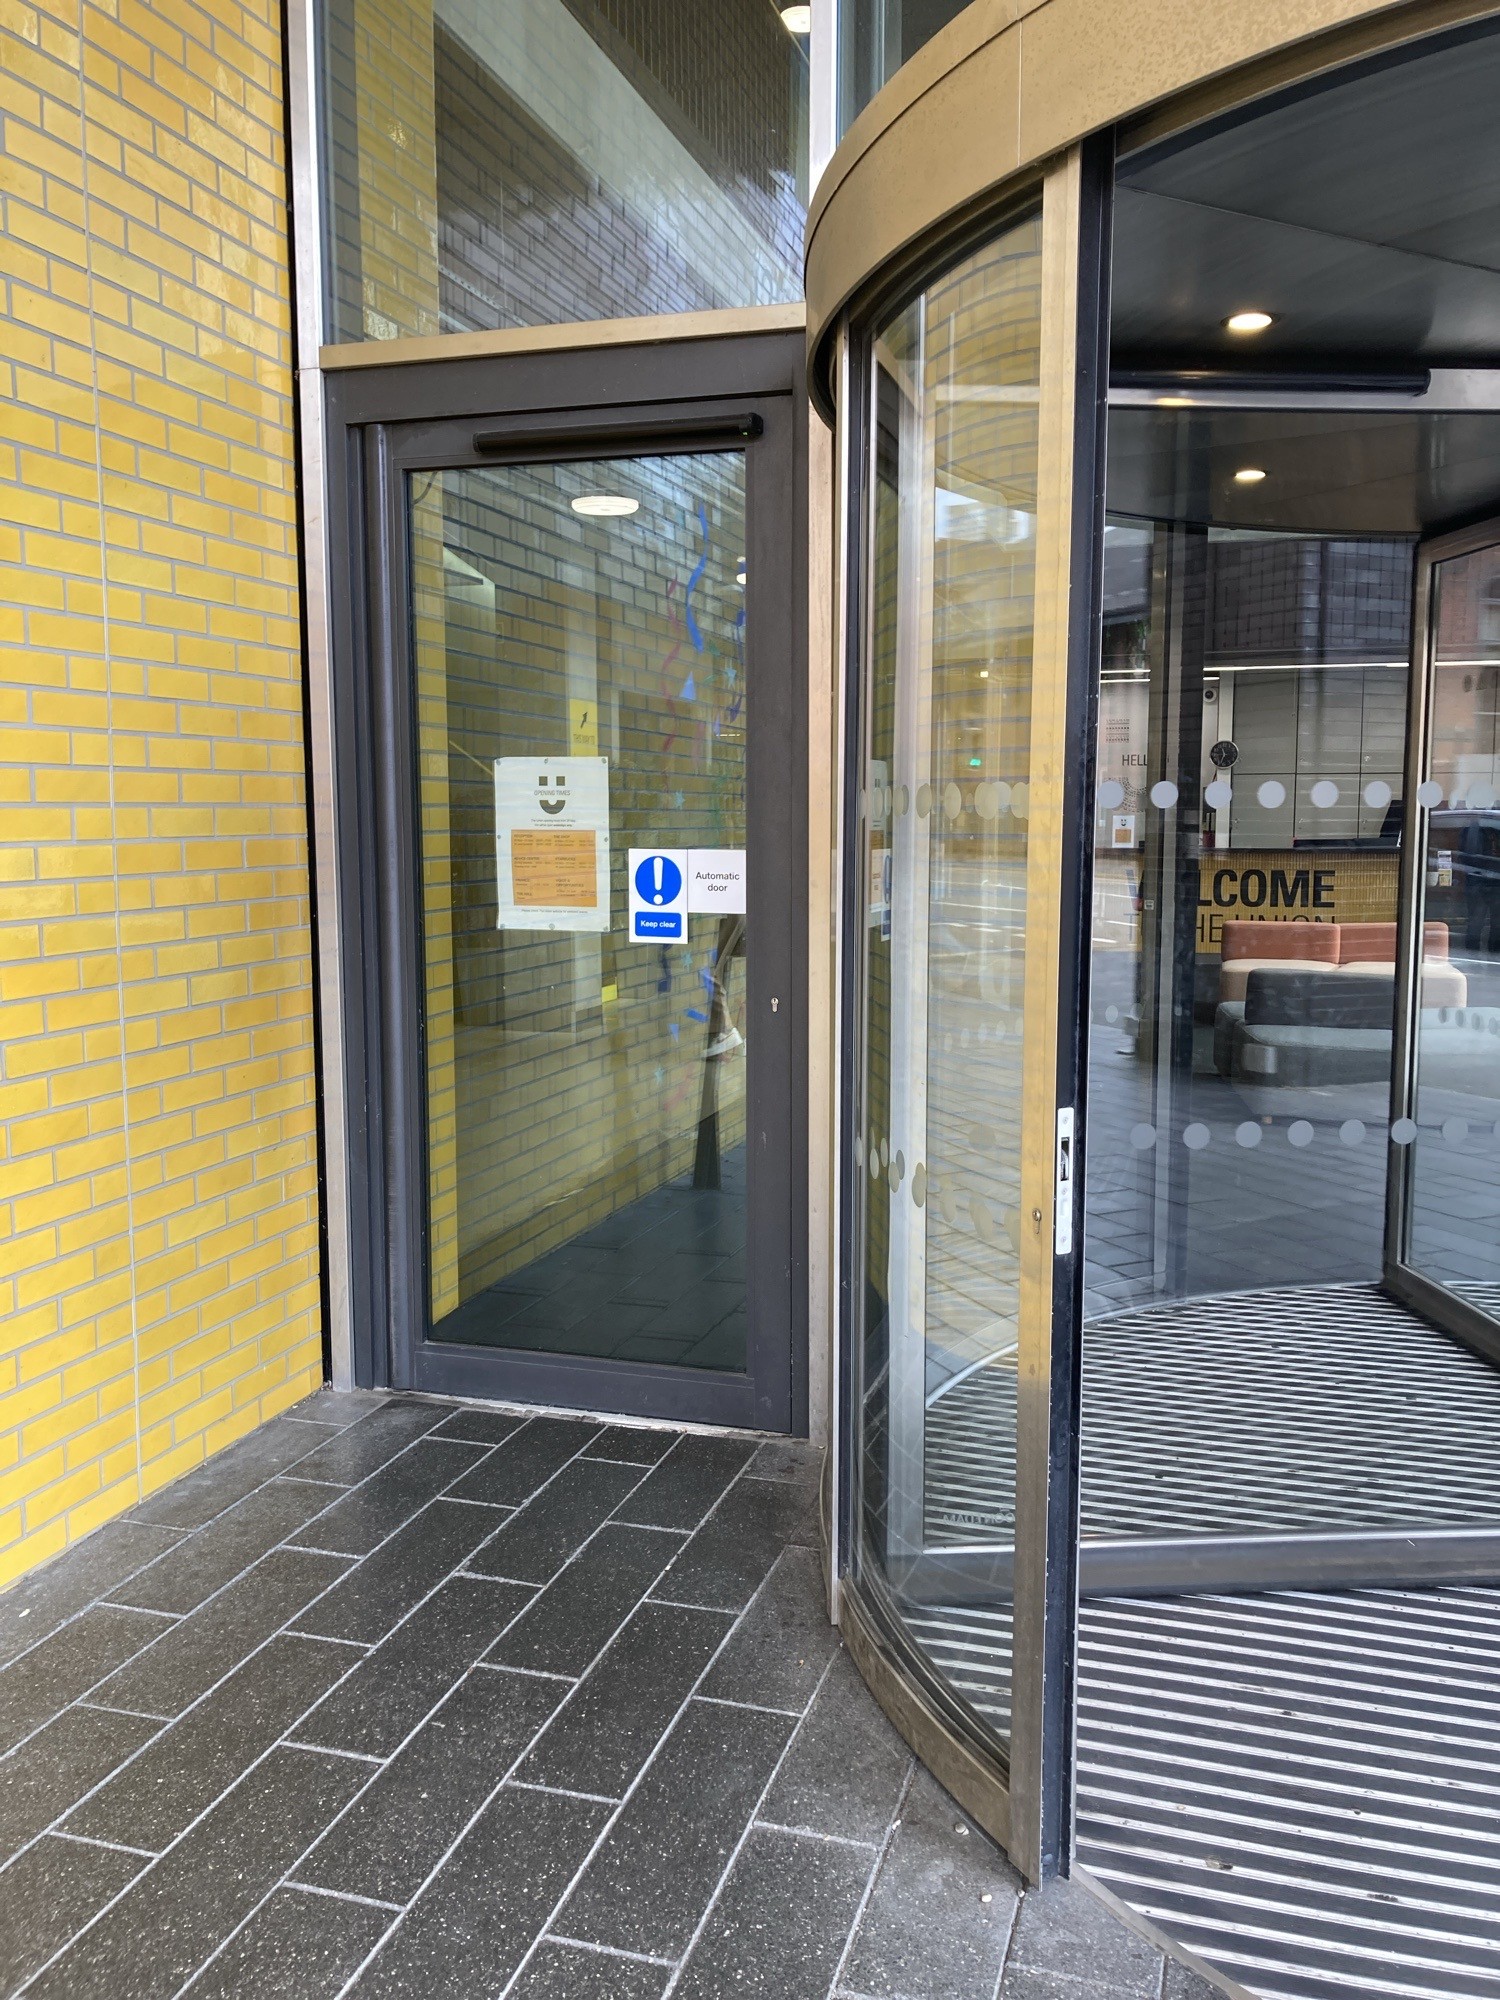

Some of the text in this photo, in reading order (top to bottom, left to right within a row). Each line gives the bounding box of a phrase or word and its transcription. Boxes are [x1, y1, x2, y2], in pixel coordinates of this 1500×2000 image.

[1121, 754, 1147, 766] HELL
[695, 872, 740, 881] Automatic
[707, 883, 728, 892] door
[640, 920, 676, 929] Keep clear
